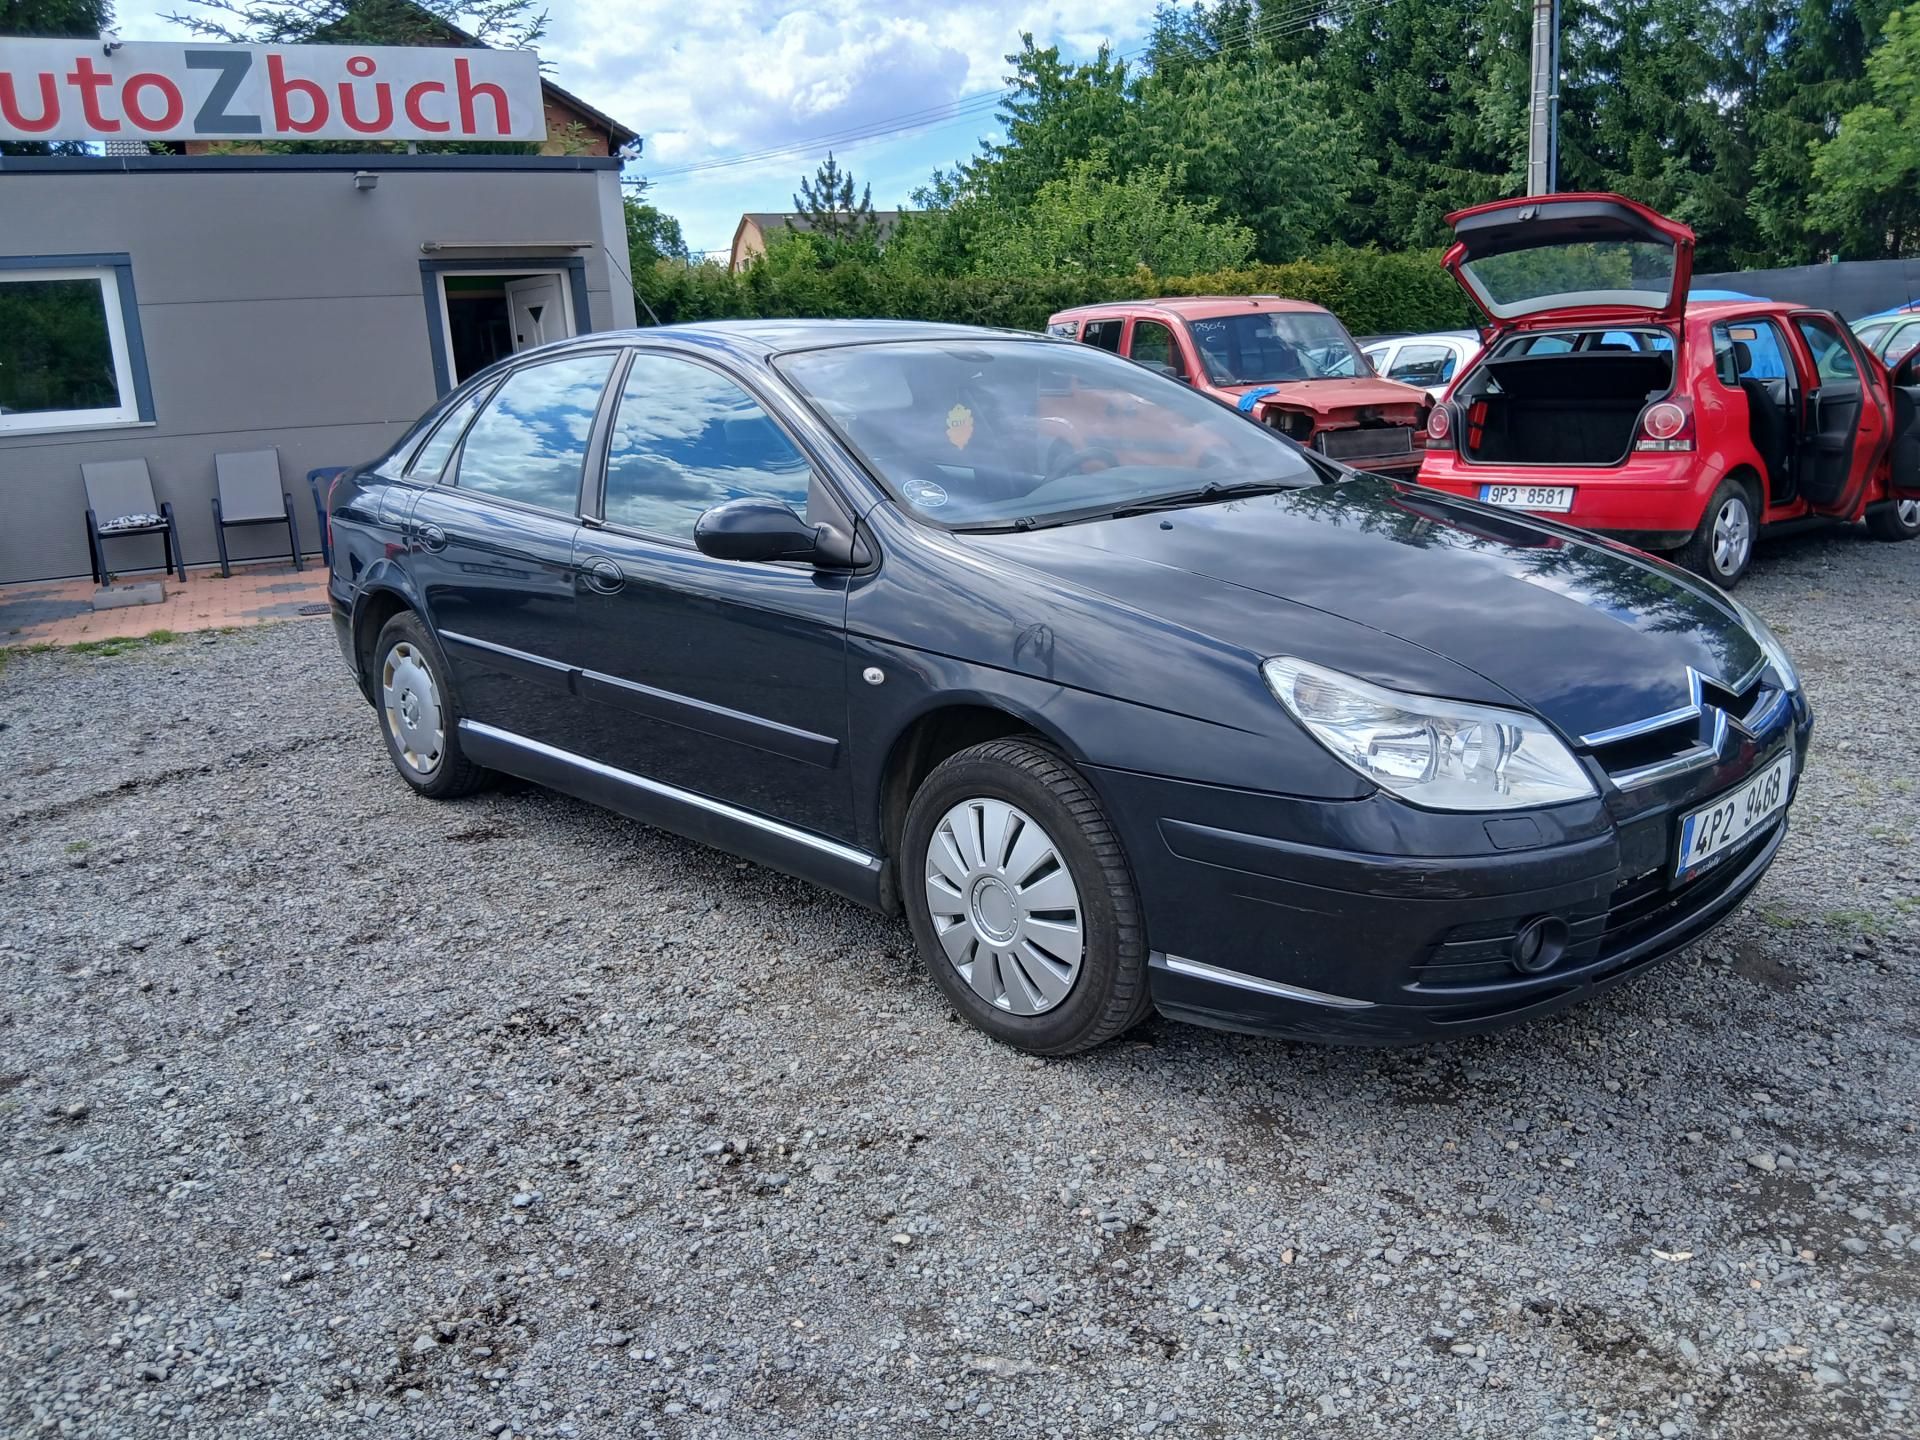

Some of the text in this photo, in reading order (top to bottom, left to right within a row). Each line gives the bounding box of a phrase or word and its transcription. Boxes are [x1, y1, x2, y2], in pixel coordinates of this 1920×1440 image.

[1491, 487, 1518, 503] 9P3
[1526, 488, 1565, 505] 8581
[1695, 802, 1735, 855] 4P2
[1744, 766, 1781, 827] 9468
